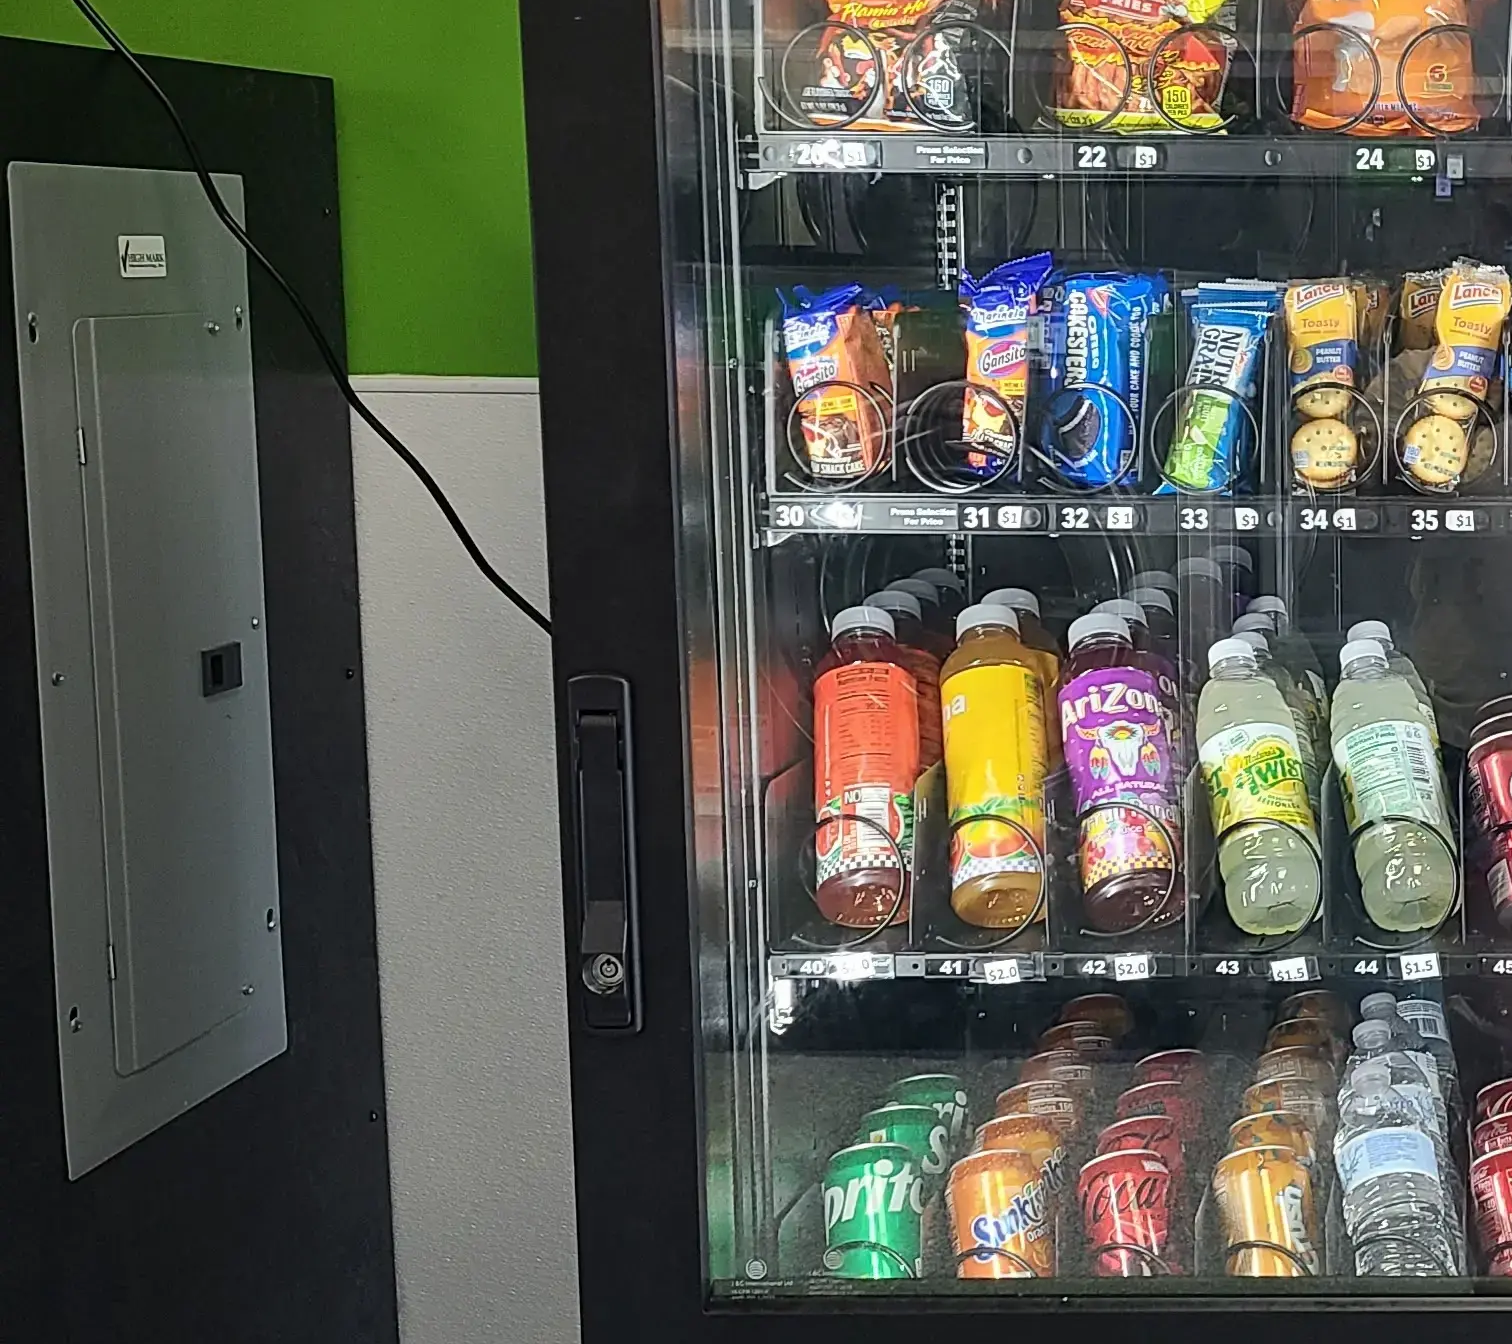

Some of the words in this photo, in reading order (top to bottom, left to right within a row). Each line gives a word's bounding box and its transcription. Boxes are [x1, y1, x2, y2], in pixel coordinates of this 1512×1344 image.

[1166, 90, 1187, 103] 150
[1078, 146, 1106, 167] 22
[1356, 148, 1384, 170] 24
[1296, 284, 1342, 304] Lance
[1453, 284, 1500, 301] Lance
[1130, 348, 1141, 365] AND
[1459, 351, 1485, 363] PEANUT
[1129, 367, 1141, 391] CAKE
[775, 506, 804, 527] 30
[963, 506, 990, 529] 31
[1001, 511, 1018, 525] $1
[1061, 507, 1089, 529] 32
[1180, 508, 1208, 530] 33
[1241, 513, 1257, 527] $1
[1300, 509, 1328, 529] 34
[1337, 514, 1354, 528] $1
[1411, 509, 1439, 531] 35
[1455, 513, 1472, 528] $1
[800, 959, 825, 975] 40
[939, 960, 963, 975] 41
[988, 966, 1017, 981] $2.0
[1081, 960, 1107, 975] 42
[1117, 962, 1146, 976] $2.0
[1215, 960, 1240, 975] 43
[1276, 967, 1305, 981] $1.5
[1354, 960, 1379, 974] 44
[1404, 960, 1433, 975] $1.5
